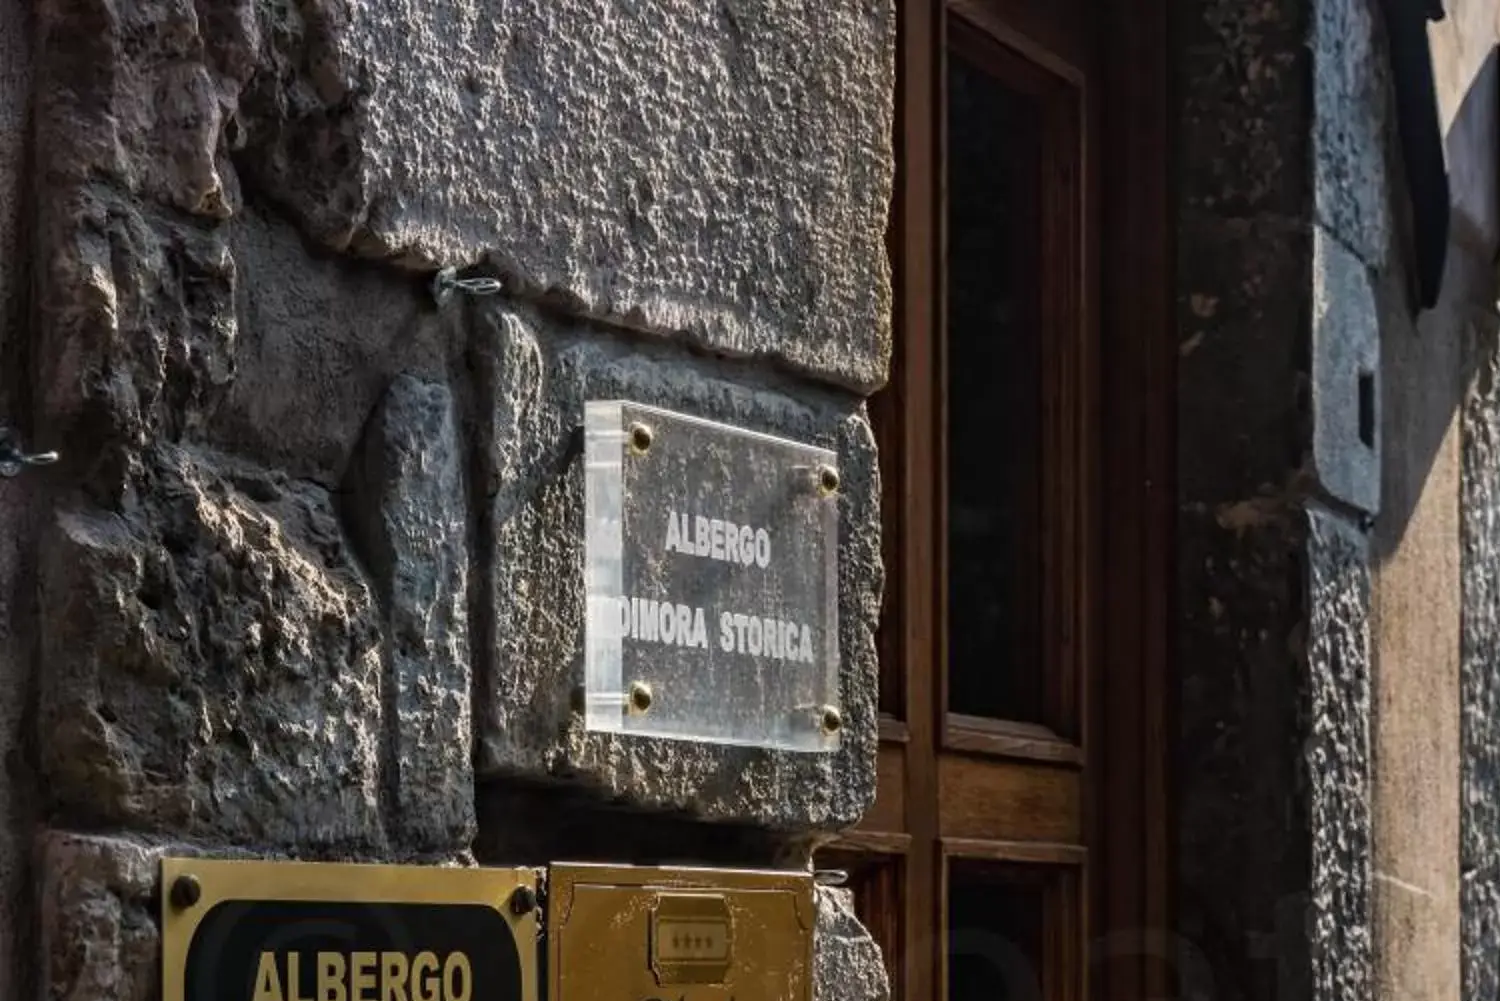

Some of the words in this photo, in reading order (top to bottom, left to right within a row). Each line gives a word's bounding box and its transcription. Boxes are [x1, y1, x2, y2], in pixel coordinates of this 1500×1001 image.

[664, 510, 772, 569] ALBERGO
[616, 595, 709, 649] DIMORA
[719, 611, 814, 663] STORICA
